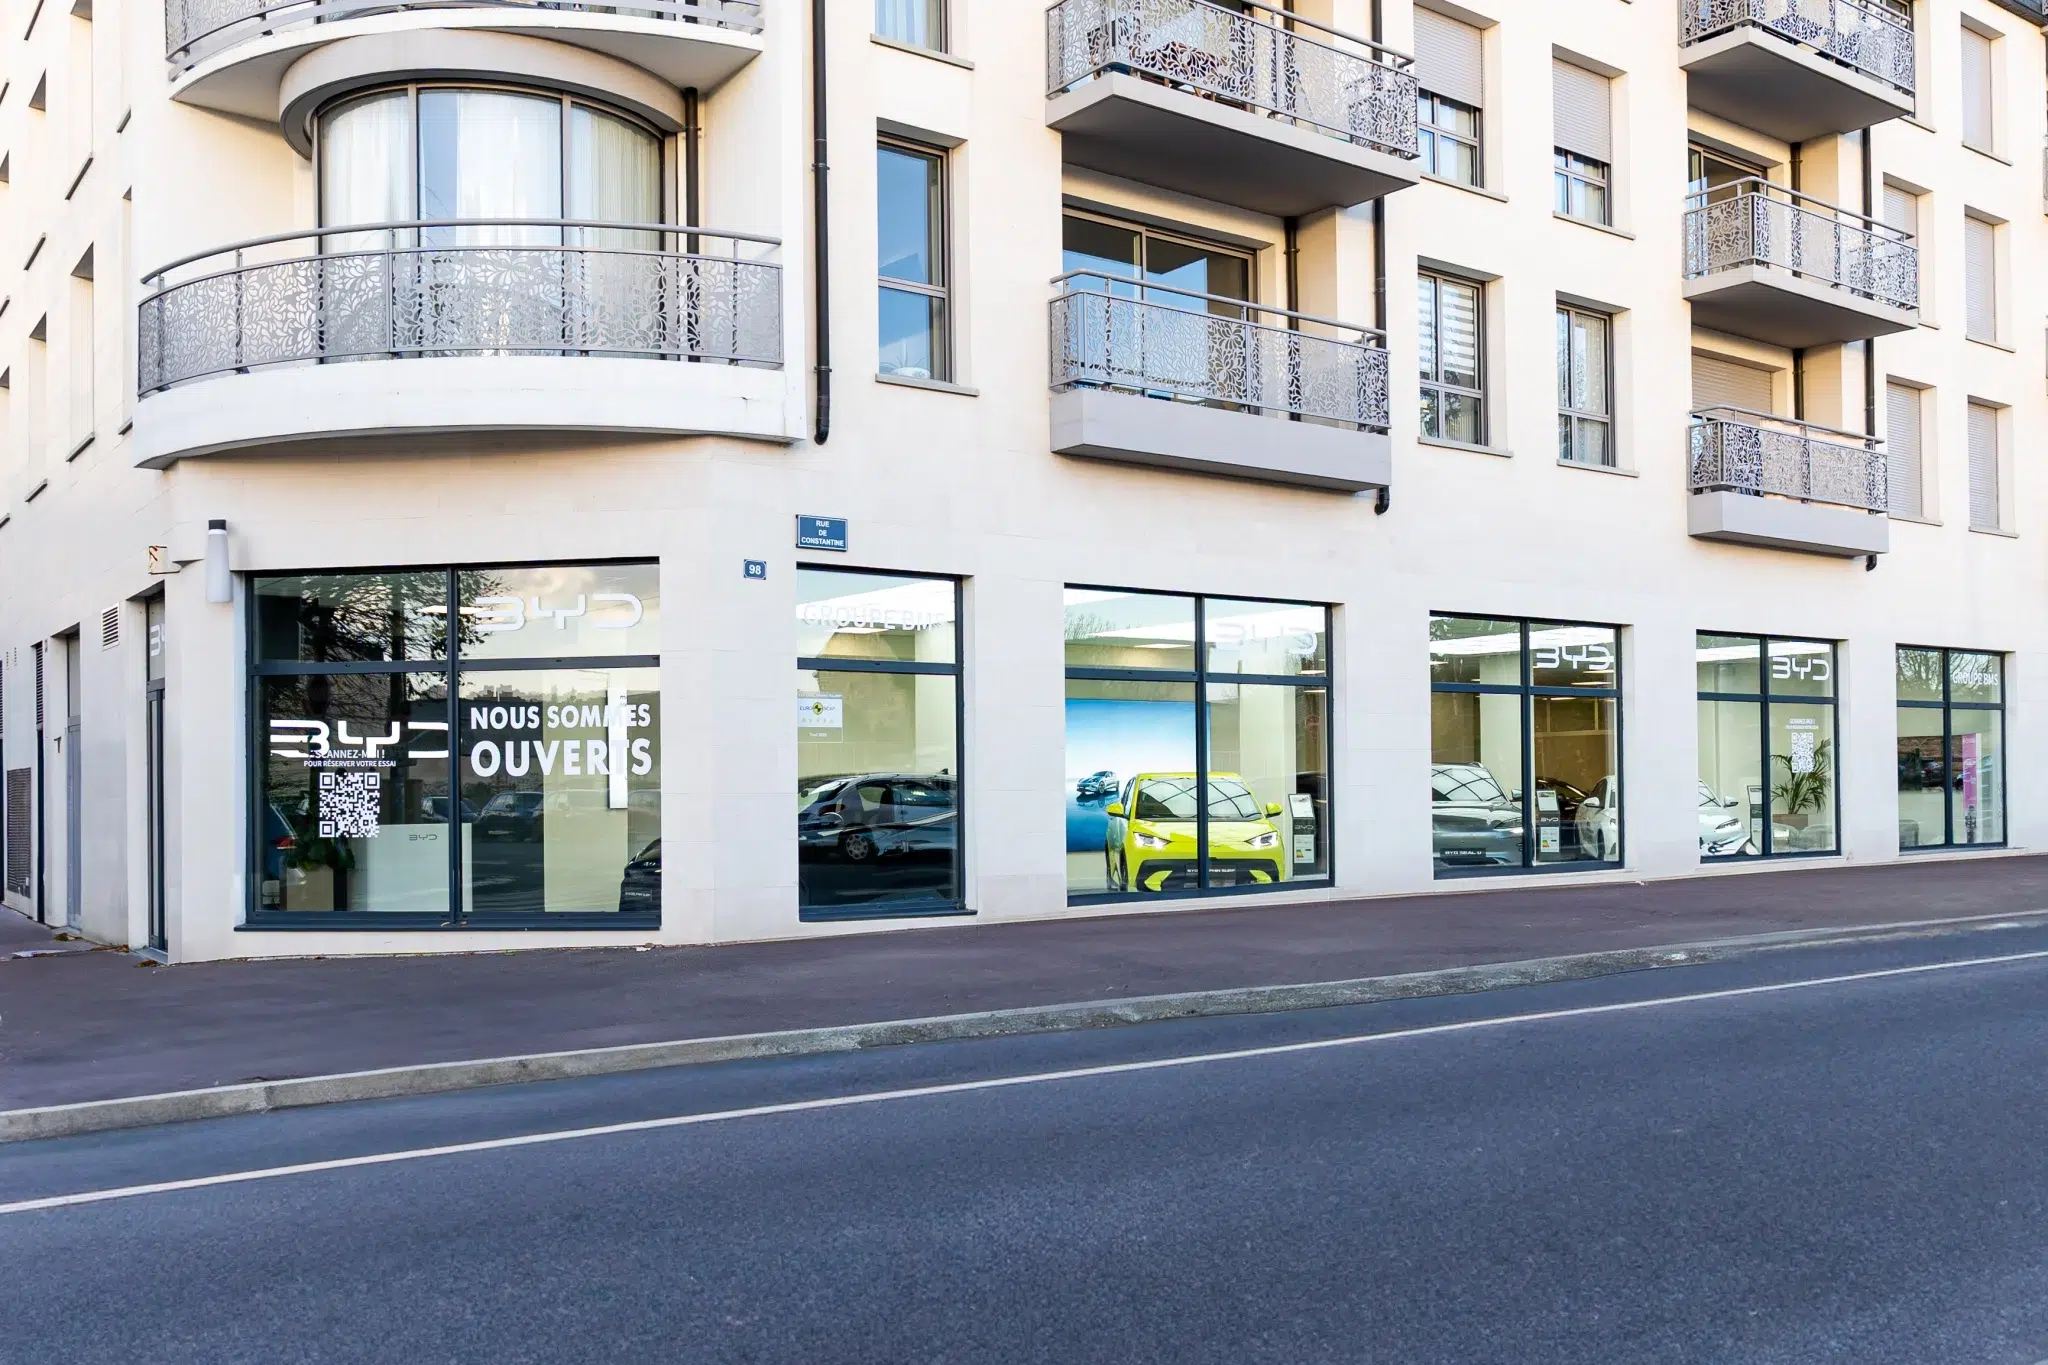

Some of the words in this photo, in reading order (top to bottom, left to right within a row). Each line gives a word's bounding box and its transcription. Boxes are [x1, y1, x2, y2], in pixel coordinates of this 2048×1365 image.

[816, 520, 830, 528] RUE
[818, 529, 828, 537] DE
[801, 536, 845, 547] CONSTANTINE
[749, 564, 761, 575] 98
[475, 593, 643, 632] BYD
[1536, 645, 1611, 670] BYD
[1772, 656, 1830, 681] BYD
[1952, 670, 1982, 685] GROUPE
[1983, 673, 1999, 686] BMS
[470, 706, 540, 730] NOUS
[547, 703, 651, 729] SOMMES
[322, 758, 355, 767] RÉSERVER
[470, 737, 652, 777] OUVERTS
